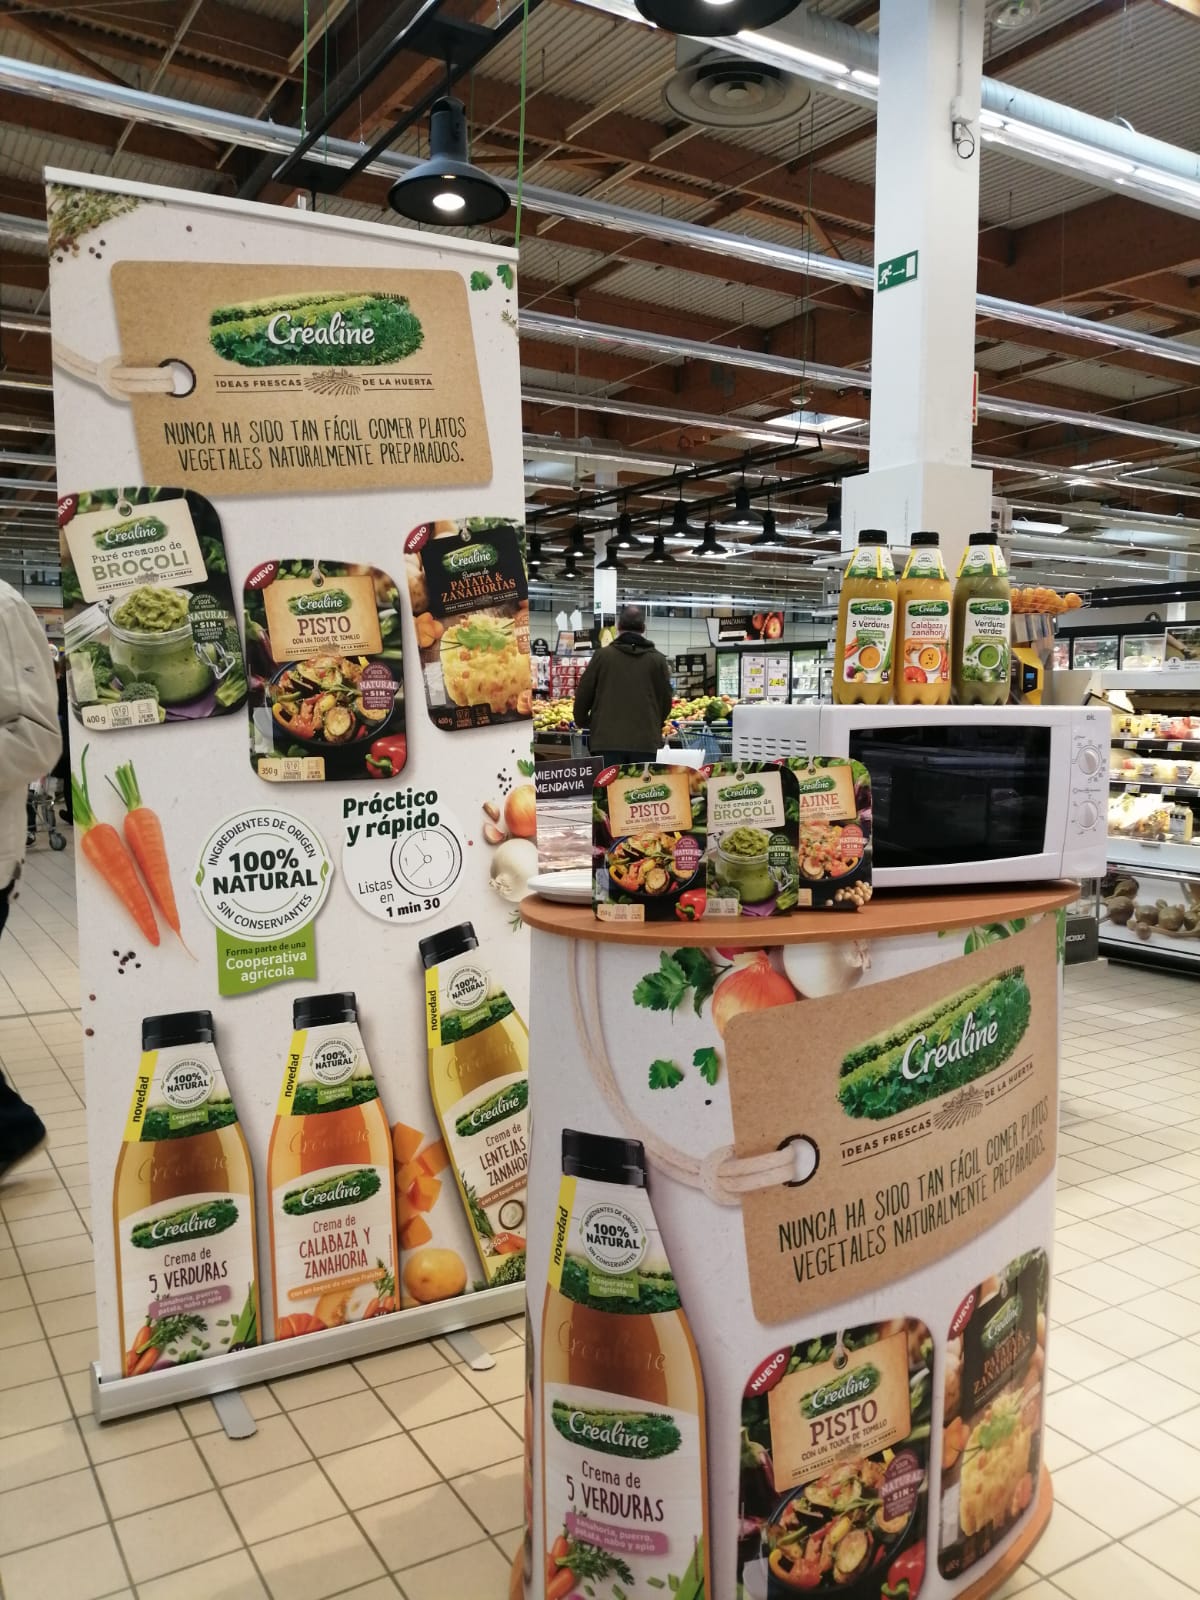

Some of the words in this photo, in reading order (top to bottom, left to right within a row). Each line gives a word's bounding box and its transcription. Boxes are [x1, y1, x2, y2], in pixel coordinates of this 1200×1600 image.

[267, 312, 375, 346] Crealine
[215, 379, 250, 388] IDEAS
[252, 378, 302, 388] FRESCAS
[362, 379, 375, 388] DE
[378, 378, 392, 387] LA
[394, 378, 432, 386] HUERTA
[164, 422, 215, 445] NUNCA
[223, 421, 242, 444] HA
[250, 420, 284, 443] SIDO
[290, 418, 320, 442] TAN
[325, 414, 362, 440] FÁCIL
[369, 418, 414, 439] COMER
[419, 417, 466, 438] PLATOS
[178, 447, 262, 472] VEGETALES
[269, 445, 372, 469] NATURALMENTE
[380, 442, 464, 466] PREPARADOS.
[105, 524, 157, 544] Crealine
[408, 526, 426, 550] NUEVO
[92, 551, 118, 564] Puré
[122, 546, 166, 560] cremoso
[168, 541, 182, 550] de
[450, 550, 491, 568] Crealine
[92, 550, 190, 581] BROCOLI
[249, 564, 274, 587] NUEVO
[442, 578, 516, 602] ZANAHORIAS
[450, 575, 492, 590] PATATA
[297, 593, 344, 612] Crealine
[188, 610, 228, 620] NATURAL
[297, 616, 352, 637] PISTO
[859, 620, 890, 628] Verduras
[975, 620, 1006, 628] Verduras
[360, 680, 397, 690] NATURAL
[536, 768, 578, 780] MIENTOS
[580, 766, 593, 776] DE
[598, 768, 616, 785] NUEVO
[800, 779, 830, 790] realine
[343, 788, 438, 819] Práctico
[630, 786, 665, 800] Crealine
[800, 793, 840, 808] AJINE
[630, 802, 670, 818] PISTO
[714, 804, 775, 820] BROCOLI
[346, 824, 360, 848] y
[366, 809, 440, 840] rápido
[208, 817, 270, 866] INGREDIENTES
[272, 818, 286, 830] DE
[286, 823, 317, 858] ORIGEN
[228, 848, 300, 873] 100%
[212, 869, 318, 896] NATURAL
[358, 879, 393, 896] Listas
[380, 892, 394, 904] en
[385, 906, 394, 918] 1
[396, 902, 422, 916] min
[424, 898, 441, 910] 30
[216, 900, 234, 920] SIN
[234, 894, 313, 930] CONSERVANTES
[226, 946, 252, 958] Forma
[254, 942, 278, 957] parte
[279, 941, 289, 951] de
[290, 940, 306, 950] una
[226, 950, 308, 974] Cooperativa
[240, 963, 295, 984] agrícola
[452, 980, 485, 1000] NATURAL
[454, 976, 478, 990] 100%
[428, 990, 437, 1031] novedad
[321, 1050, 346, 1062] 100%
[902, 1012, 998, 1080] Crealine
[285, 1054, 300, 1098] novedad
[315, 1058, 354, 1070] NATURAL
[167, 1080, 209, 1093] NATURAL
[174, 1072, 202, 1084] 100%
[132, 1076, 150, 1122] novedad
[842, 1140, 879, 1159] IDEAS
[882, 1118, 932, 1145] FRESCAS
[984, 1088, 996, 1100] DE
[997, 1083, 1007, 1092] LA
[1008, 1062, 1034, 1086] HUERTA
[470, 1096, 520, 1127] Crealine
[485, 1130, 511, 1148] Crema
[512, 1123, 522, 1133] de
[480, 1136, 526, 1171] LENTEJAS
[778, 1208, 838, 1253] NUNCA
[846, 1198, 866, 1231] HA
[874, 1182, 910, 1221] SIDO
[919, 1166, 944, 1198] TAN
[950, 1148, 982, 1187] FÁCIL
[986, 1128, 1018, 1166] COMER
[1020, 1096, 1049, 1140] PLATOS
[302, 1180, 361, 1207] Crealine
[793, 1224, 887, 1284] VEGETALES
[892, 1174, 988, 1248] NATURALMENTE
[992, 1131, 1046, 1193] PREPARADOS.
[152, 1212, 217, 1240] Crealine
[313, 1219, 342, 1234] Crema
[346, 1214, 356, 1226] de
[593, 1222, 630, 1238] 100%
[299, 1232, 358, 1258] CALABAZA
[364, 1226, 370, 1245] Y
[554, 1207, 569, 1266] novedad
[586, 1233, 640, 1250] NATURAL
[164, 1252, 196, 1268] Crema
[200, 1248, 212, 1260] de
[304, 1250, 368, 1280] ZANAHORIA
[148, 1274, 158, 1294] 5
[163, 1260, 228, 1290] VERDURAS
[952, 1293, 975, 1334] NUEVO
[752, 1352, 785, 1391] NUEVO
[812, 1373, 870, 1409] Crealine
[569, 1411, 649, 1450] Crealine
[810, 1398, 878, 1447] PISTO
[802, 1448, 816, 1461] CON
[818, 1445, 828, 1455] UN
[852, 1431, 861, 1440] DE
[862, 1418, 888, 1436] TOMILLO
[582, 1460, 620, 1486] Crema
[626, 1472, 641, 1489] de
[566, 1474, 575, 1501] 5
[581, 1482, 664, 1522] VERDURAS
[892, 1488, 910, 1500] SIN
